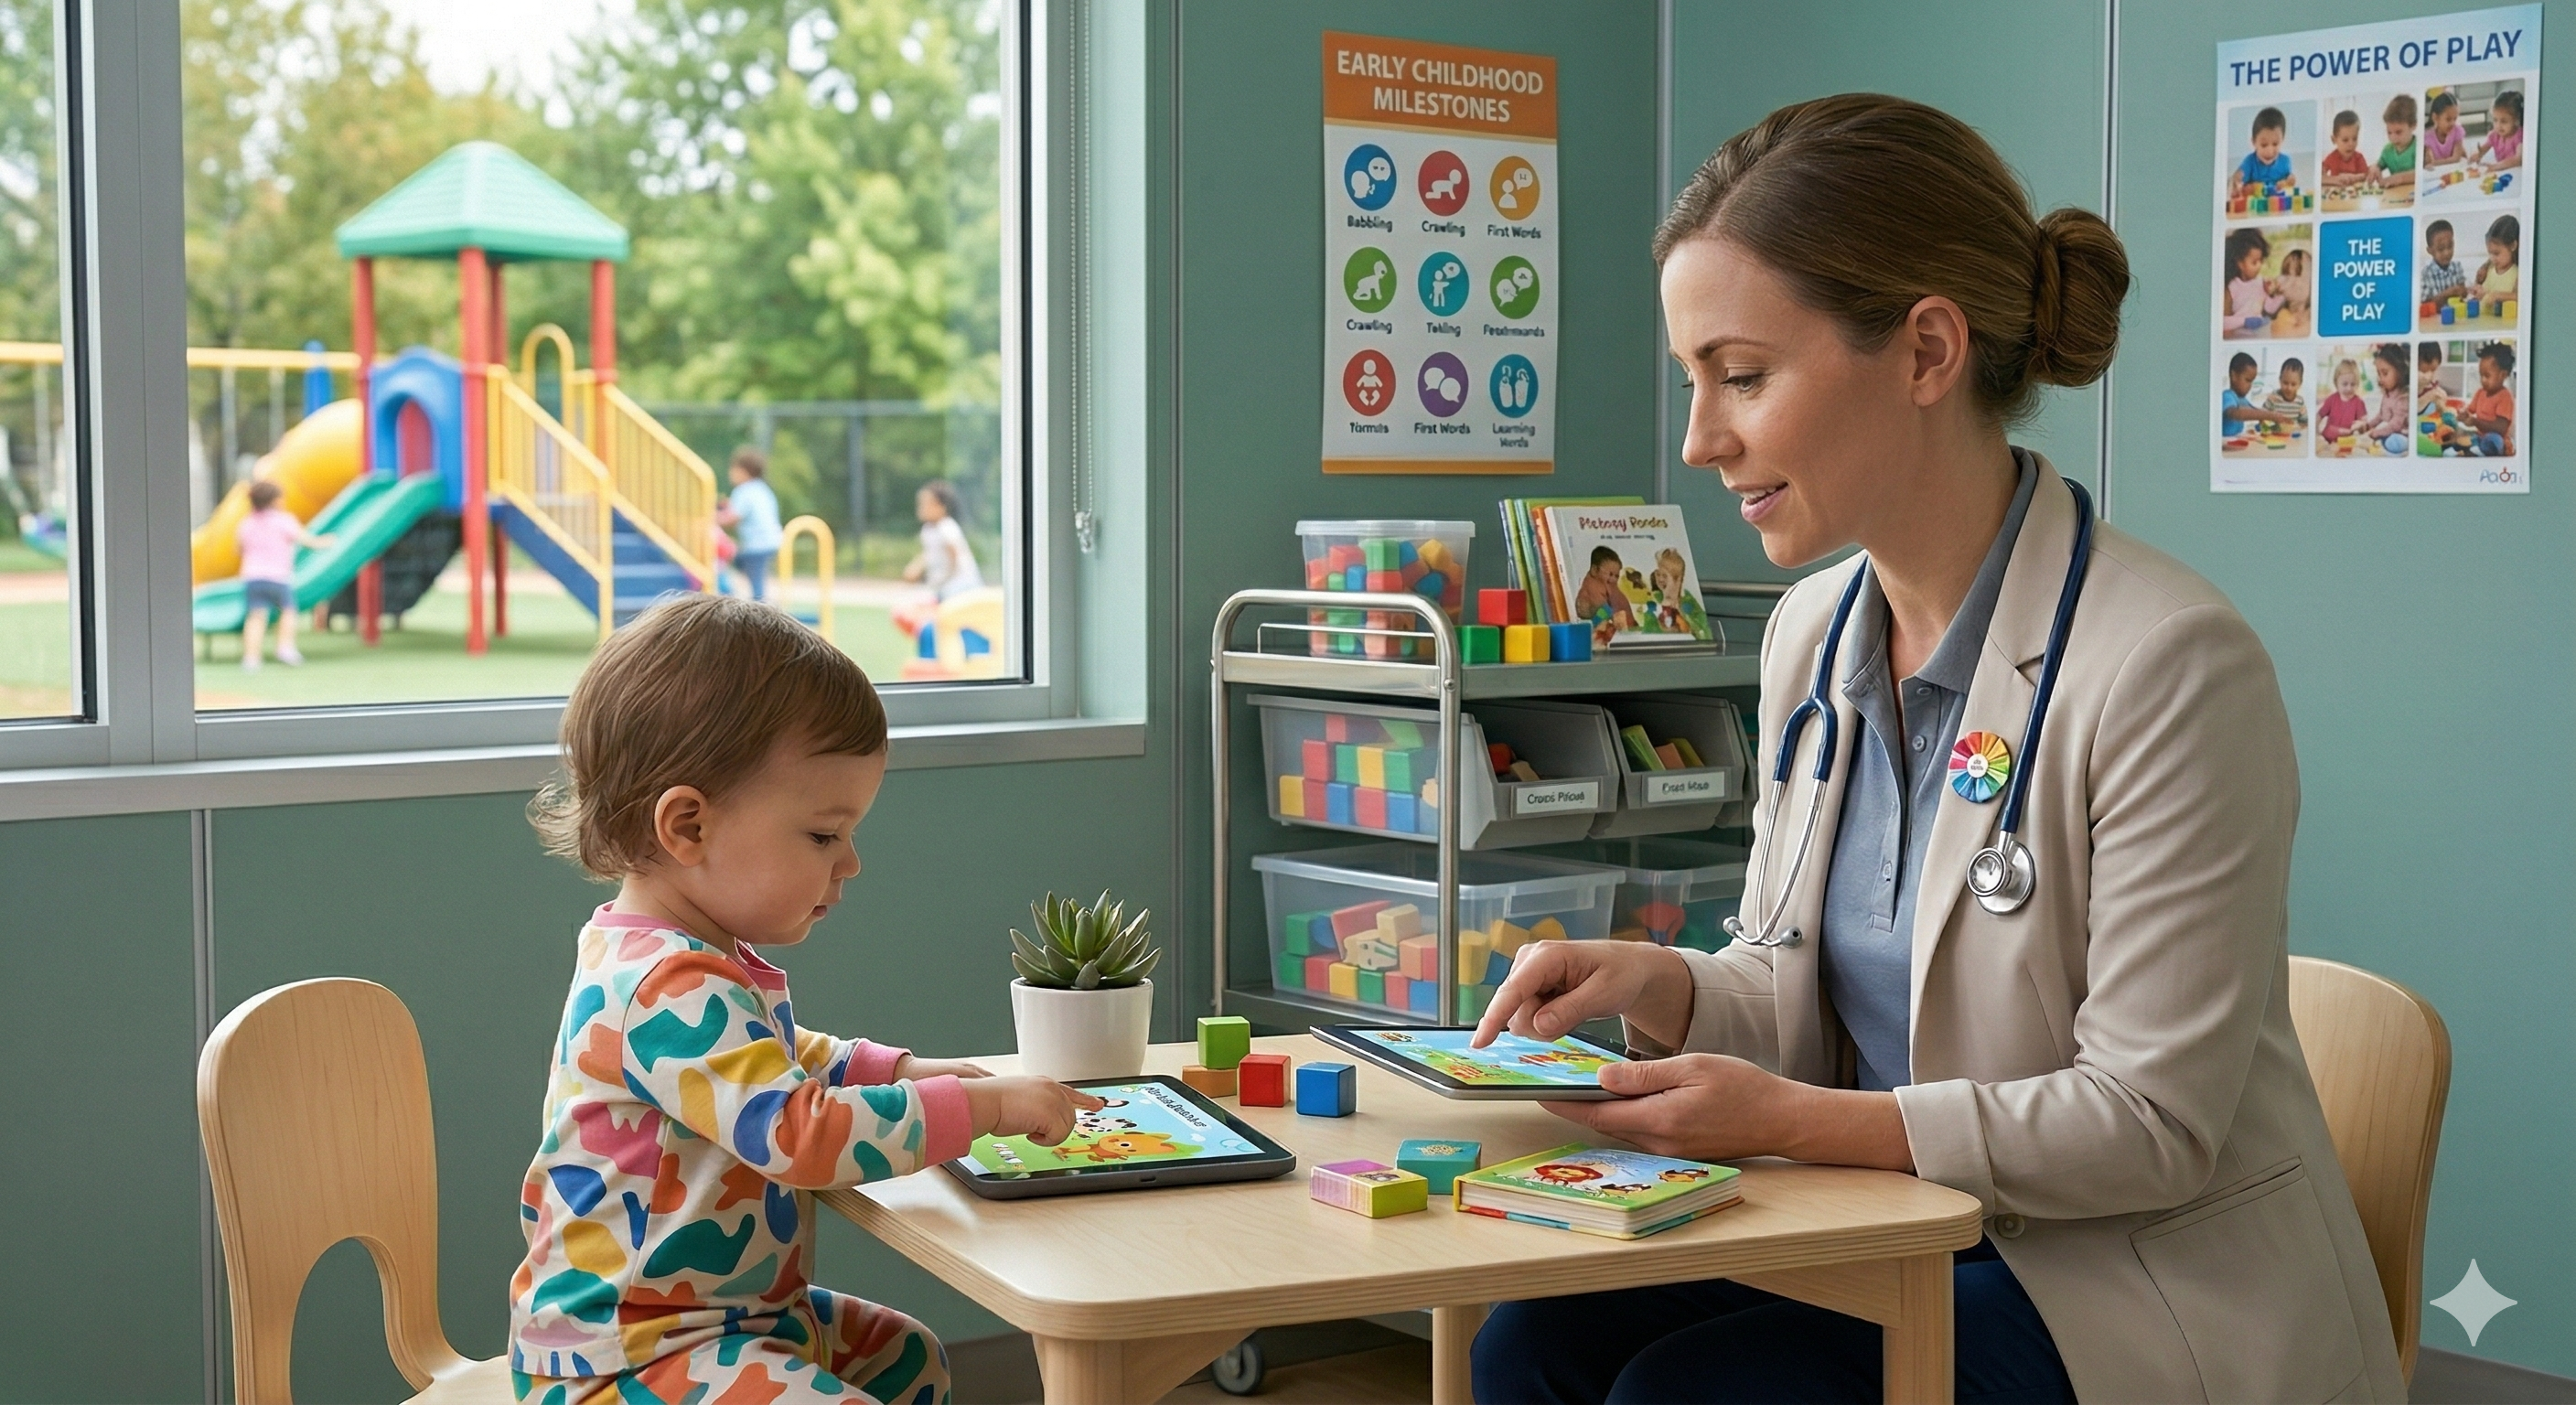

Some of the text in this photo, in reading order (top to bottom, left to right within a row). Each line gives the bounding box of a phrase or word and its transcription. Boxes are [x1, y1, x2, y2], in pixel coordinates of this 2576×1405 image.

[2230, 28, 2523, 87] THE POWER OF PLAY
[1337, 49, 1543, 94] EARLY CHILDHOOD
[1374, 86, 1510, 123] MILESTONES
[2347, 238, 2382, 256] THE
[2334, 259, 2396, 278] POWER
[2352, 282, 2376, 299] OF
[2342, 303, 2385, 321] PLAY
[1413, 422, 1437, 434] First
